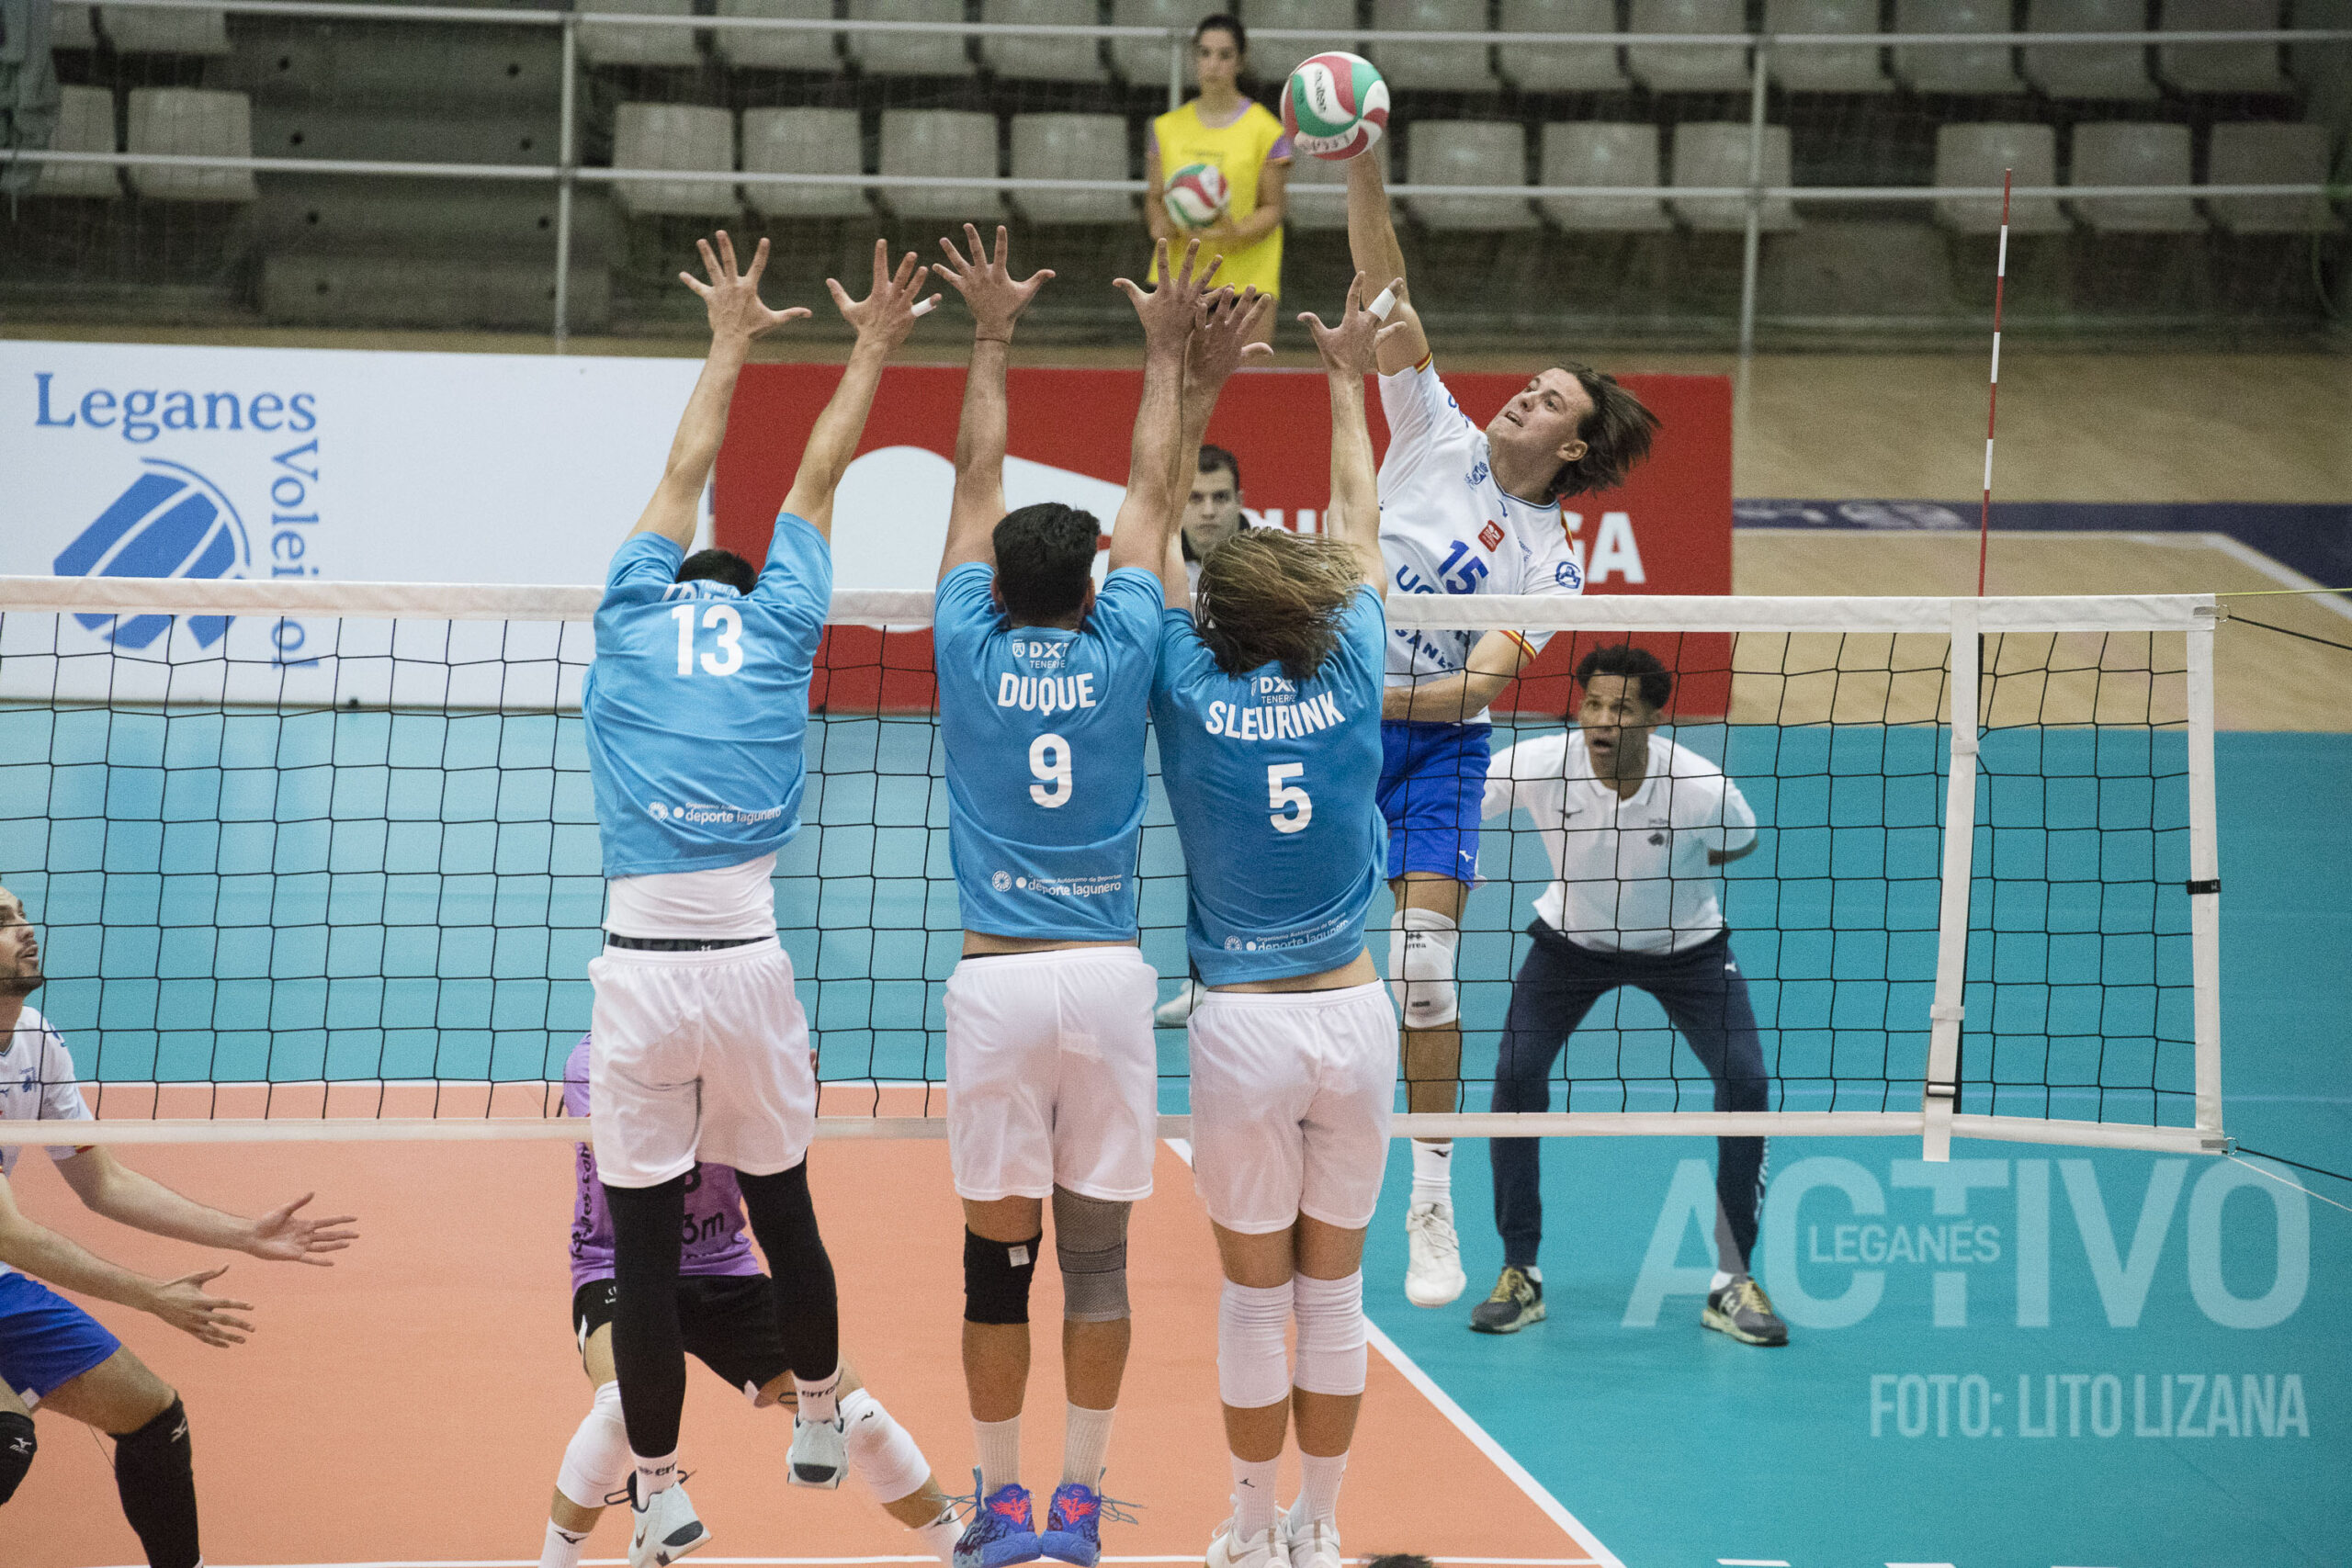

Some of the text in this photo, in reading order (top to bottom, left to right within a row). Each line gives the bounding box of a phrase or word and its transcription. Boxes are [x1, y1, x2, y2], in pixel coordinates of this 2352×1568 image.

[34, 371, 318, 444] Leganes
[271, 439, 320, 670] Voleiol
[1437, 539, 1489, 595] 15
[672, 604, 743, 677] 13
[997, 671, 1097, 716] DUQUE
[1205, 690, 1346, 740] SLEURINK
[1029, 733, 1073, 808] 9
[1267, 761, 1313, 834] 5
[685, 808, 734, 826] deporte
[1028, 878, 1122, 897] deporte lagunero
